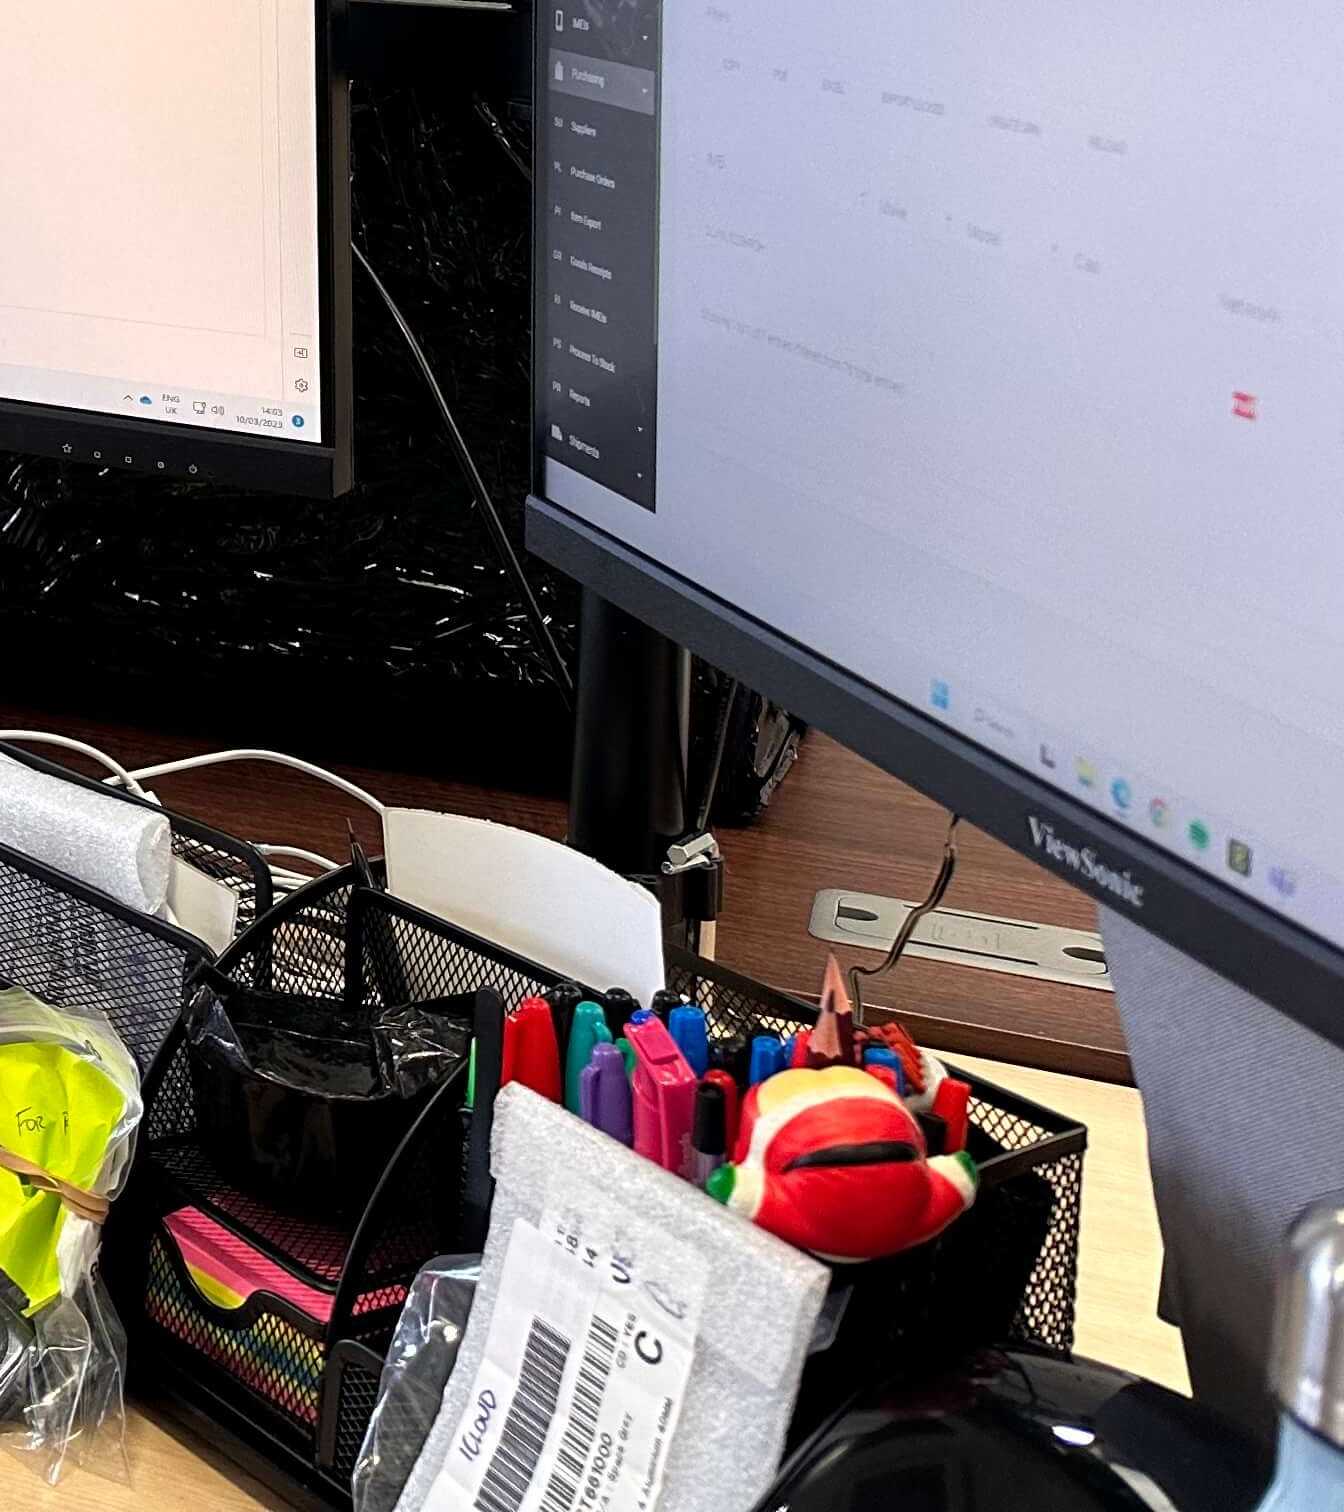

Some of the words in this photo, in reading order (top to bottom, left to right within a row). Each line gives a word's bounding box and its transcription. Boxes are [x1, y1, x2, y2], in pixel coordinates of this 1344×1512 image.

[1028, 816, 1144, 907] ViewSonic
[15, 1105, 47, 1137] FOR
[634, 1330, 664, 1365] C
